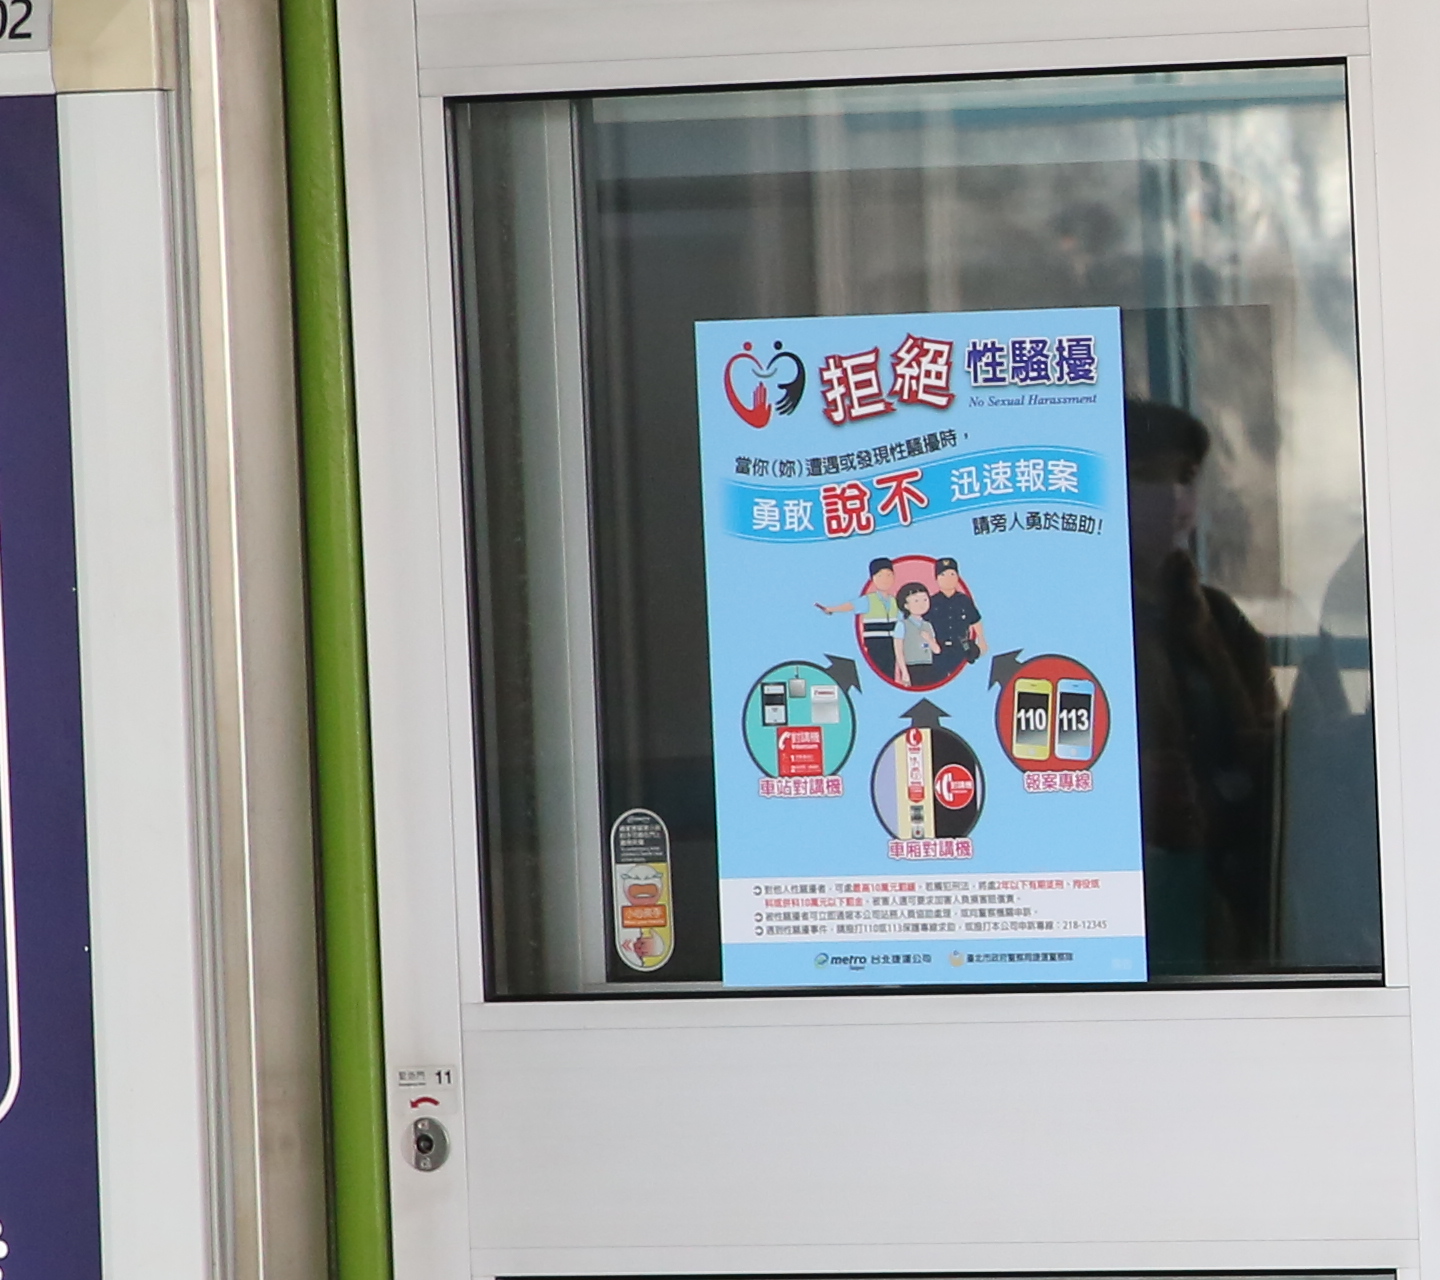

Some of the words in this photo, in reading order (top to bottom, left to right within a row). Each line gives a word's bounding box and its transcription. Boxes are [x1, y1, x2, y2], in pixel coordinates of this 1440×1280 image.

[821, 335, 953, 424] 拒絕
[967, 337, 1097, 385] 性騷擾
[969, 397, 984, 407] No
[989, 395, 1024, 407] Sexual
[1028, 393, 1097, 405] Harassment
[753, 499, 813, 532] 勇敢
[820, 469, 927, 538] 說不
[951, 459, 1078, 502] 迅速報案
[1017, 708, 1046, 731] 110
[1059, 708, 1089, 731] 113
[760, 778, 843, 797] 車站對講機
[1025, 772, 1093, 790] 報案專線
[830, 954, 867, 965] metro
[436, 1070, 451, 1084] 11
